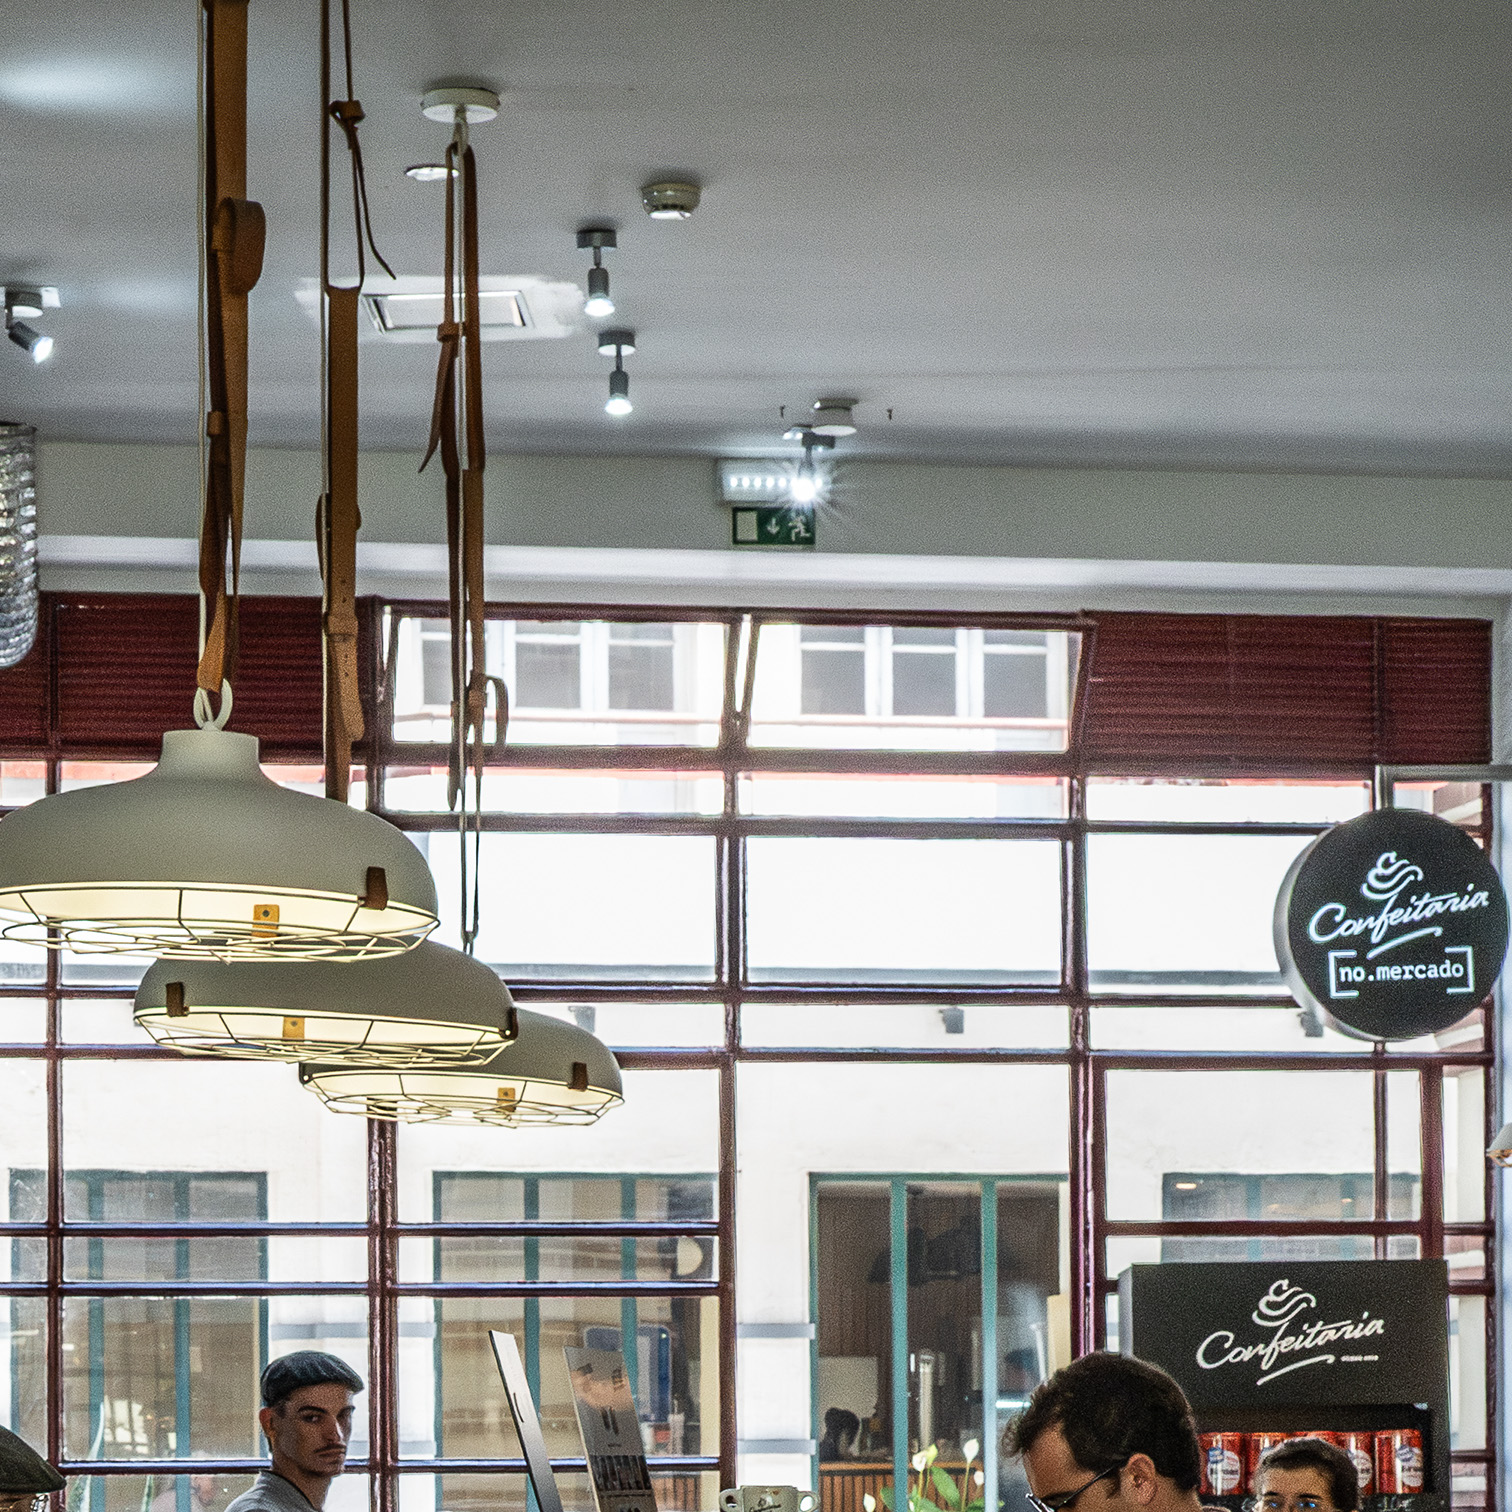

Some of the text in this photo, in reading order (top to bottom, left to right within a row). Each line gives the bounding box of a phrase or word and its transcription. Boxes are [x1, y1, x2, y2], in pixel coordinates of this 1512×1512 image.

[1308, 883, 1489, 943] Confeitaria
[1339, 960, 1464, 982] no.mercado
[1196, 1311, 1384, 1370] Confeitaria
